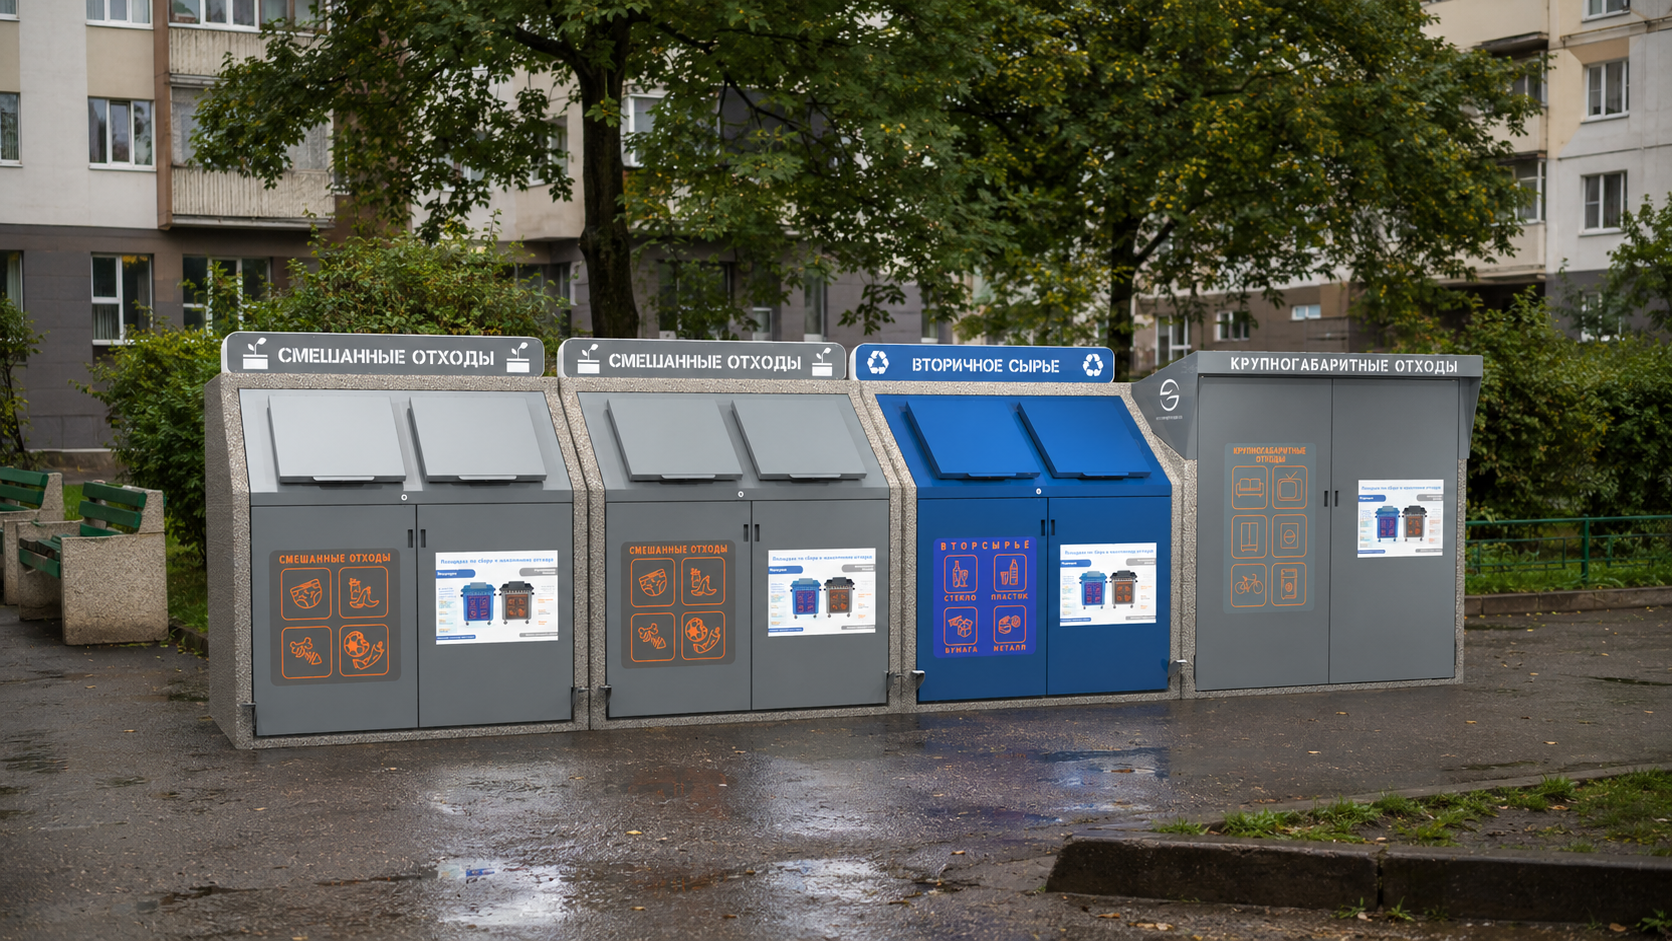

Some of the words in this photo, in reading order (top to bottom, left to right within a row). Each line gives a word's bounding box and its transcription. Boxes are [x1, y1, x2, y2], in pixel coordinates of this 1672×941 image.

[277, 347, 406, 365] СМЕШАННЫЕ
[412, 349, 495, 369] ОТХОДЫ
[608, 353, 722, 370] СМЕШАННЫЕ
[727, 355, 802, 373] ОТХОДЫ
[912, 357, 1003, 373] ВТОРИЧНОЕ
[1008, 359, 1060, 374] СЫРЬЕ
[1230, 356, 1389, 373] КРУПНОГАБАРИТНЫЕ
[1395, 359, 1458, 375] ОТХОДЫ
[629, 545, 688, 555] СМЕШАННЫЕ
[690, 544, 728, 555] ОТХОДЫ
[940, 540, 1030, 551] ВТОРСЫРЬЕ
[278, 553, 346, 564] СМЕШАННЫЕ
[349, 552, 391, 564] ОТХОДЫ
[943, 594, 977, 602] СТЕКЛО
